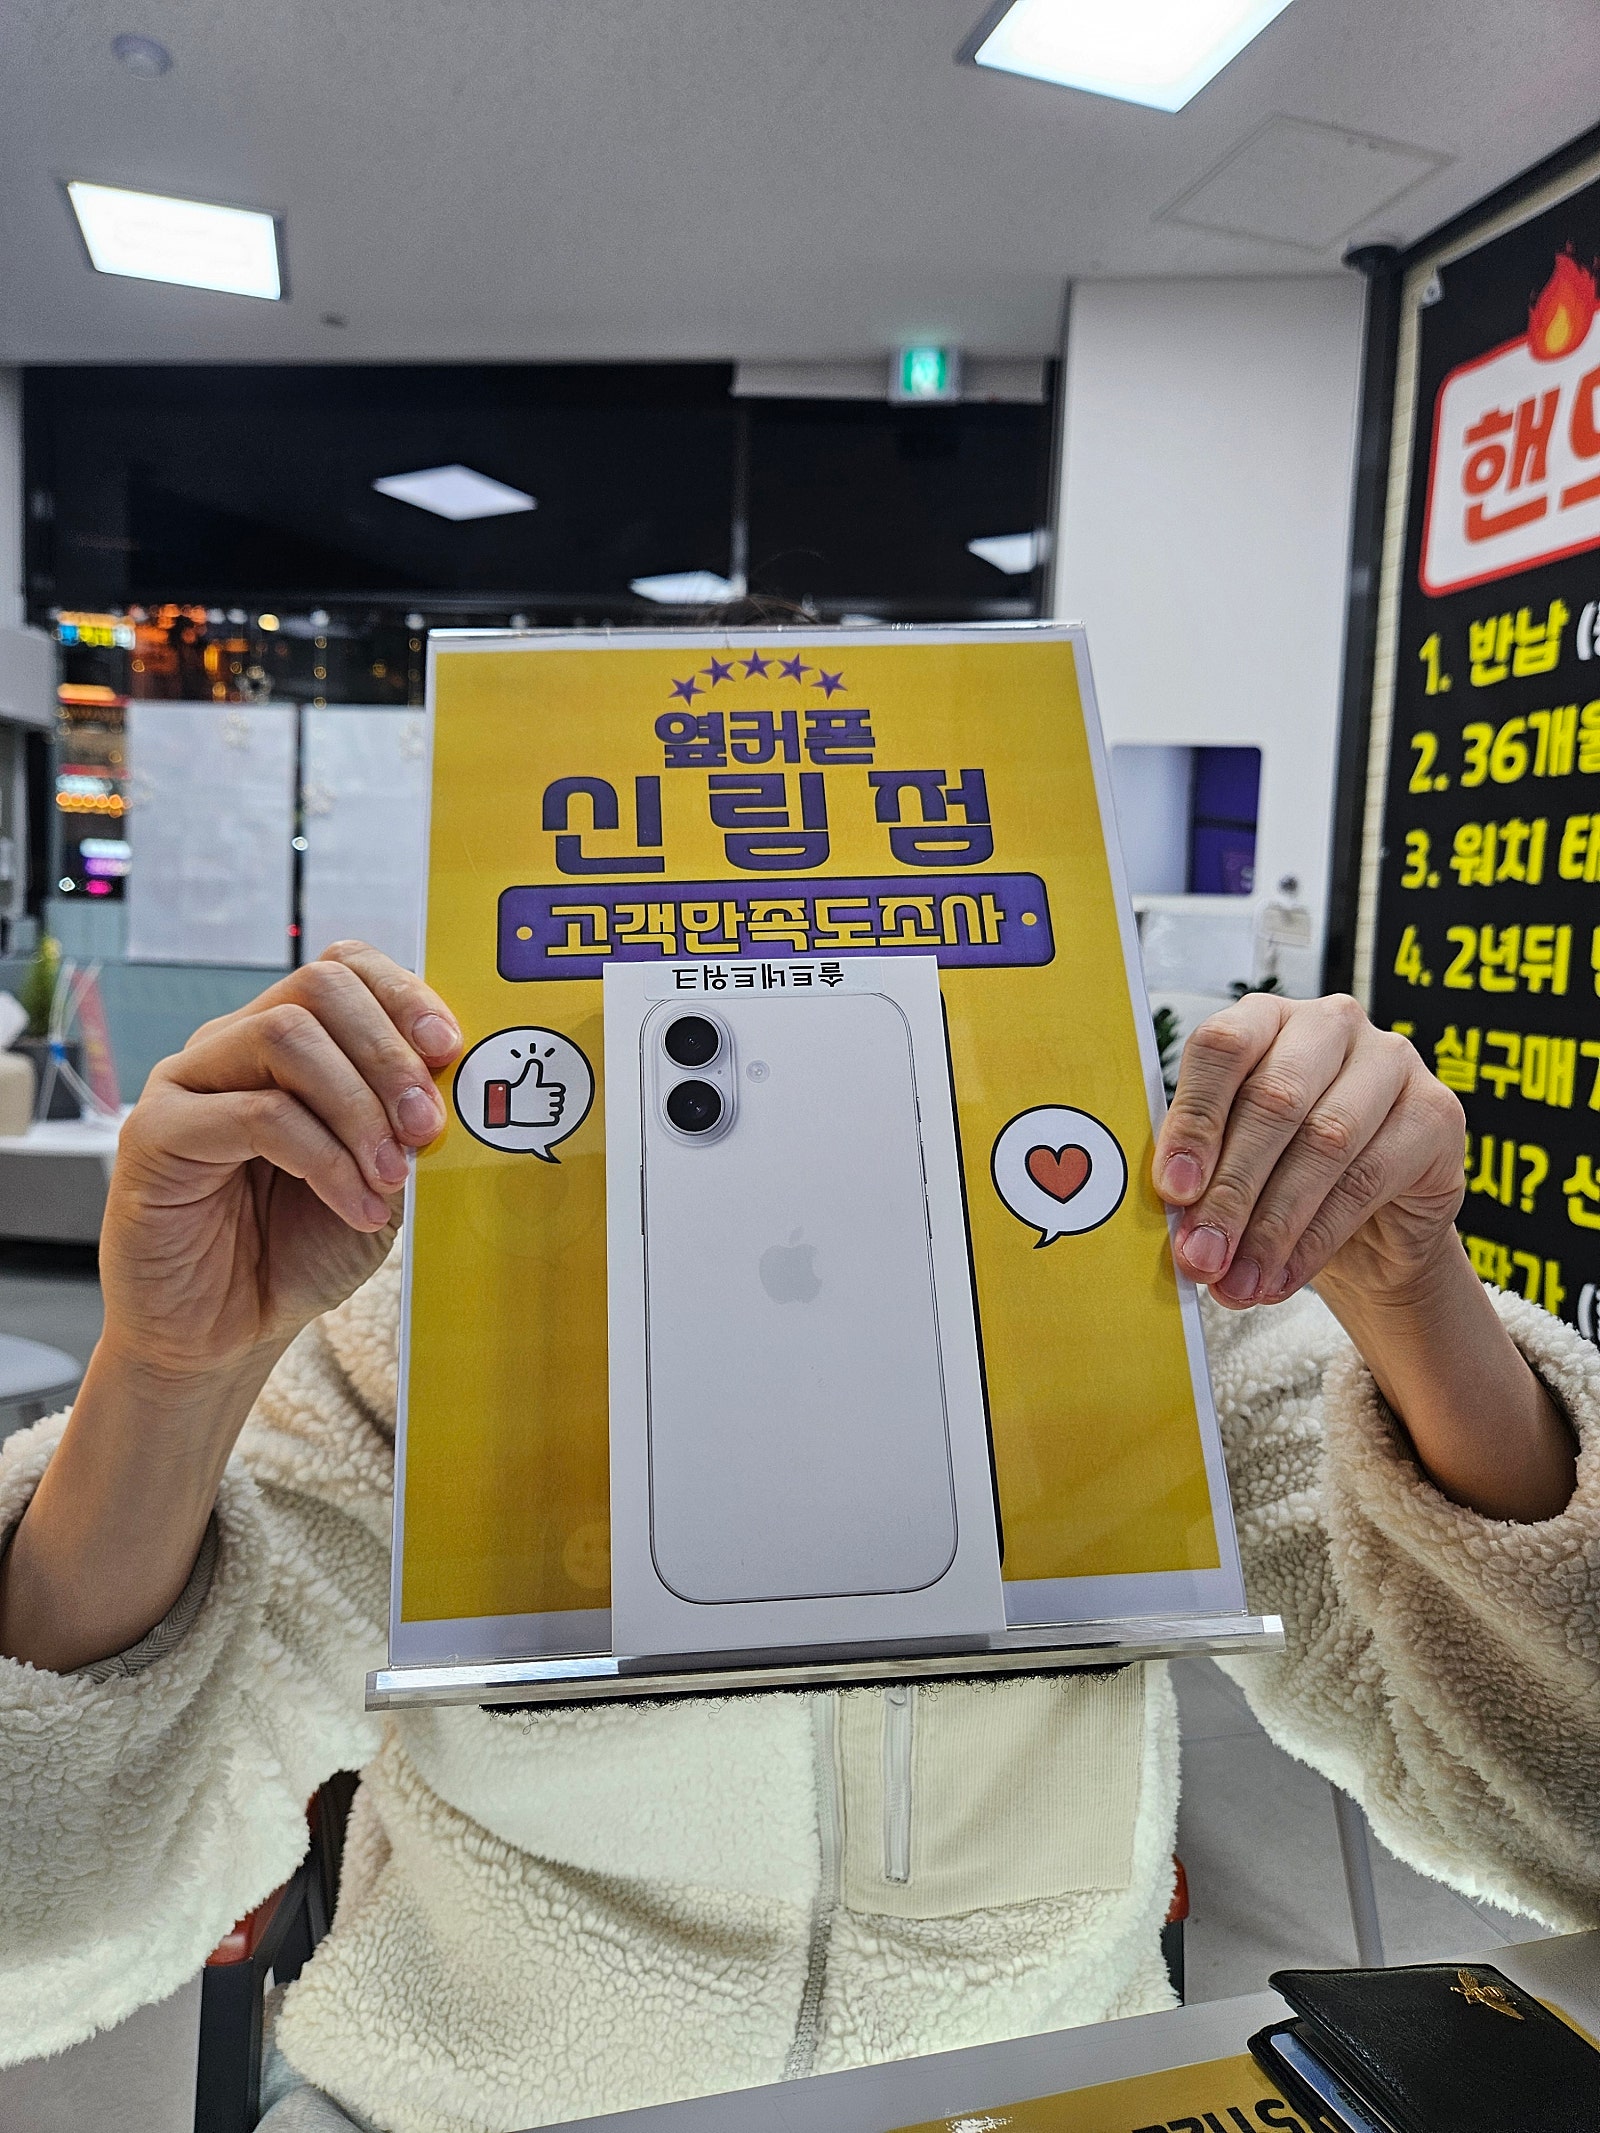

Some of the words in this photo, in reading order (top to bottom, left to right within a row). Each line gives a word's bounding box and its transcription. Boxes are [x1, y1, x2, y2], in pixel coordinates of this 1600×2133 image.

[1420, 632, 1451, 695] 1.
[1470, 599, 1569, 687] 반납
[654, 708, 875, 768] 옆커폰
[1409, 731, 1449, 794] 2.
[1401, 829, 1440, 889] 3.
[1450, 817, 1548, 887] 워치
[547, 895, 1003, 957] 고객만족도조사
[671, 961, 845, 991] 솔트네트워크
[1394, 924, 1432, 987] 4.
[1443, 924, 1572, 995] 2년뒤
